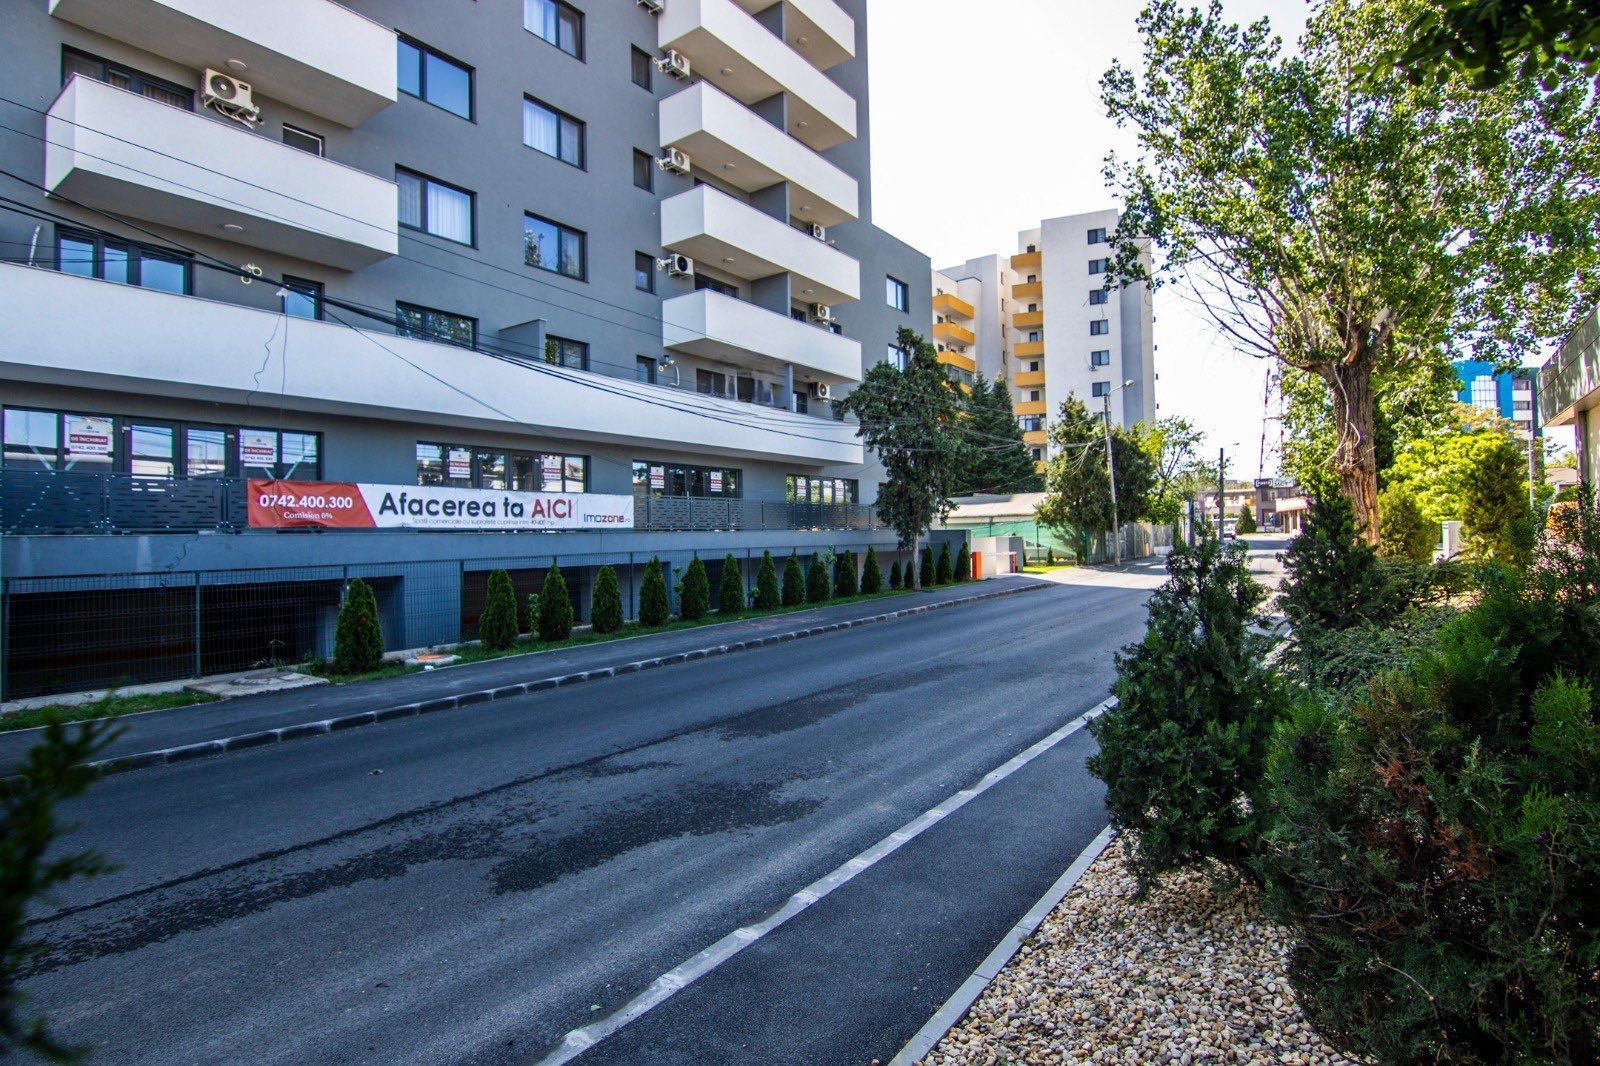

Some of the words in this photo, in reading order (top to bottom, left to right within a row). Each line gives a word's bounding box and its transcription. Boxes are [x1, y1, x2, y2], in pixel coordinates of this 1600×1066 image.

[259, 494, 353, 509] 0742.400.300
[378, 491, 496, 517] Afacerea
[503, 496, 524, 518] ta
[531, 498, 572, 519] AICI
[283, 511, 320, 520] Comision
[321, 511, 333, 520] 0%
